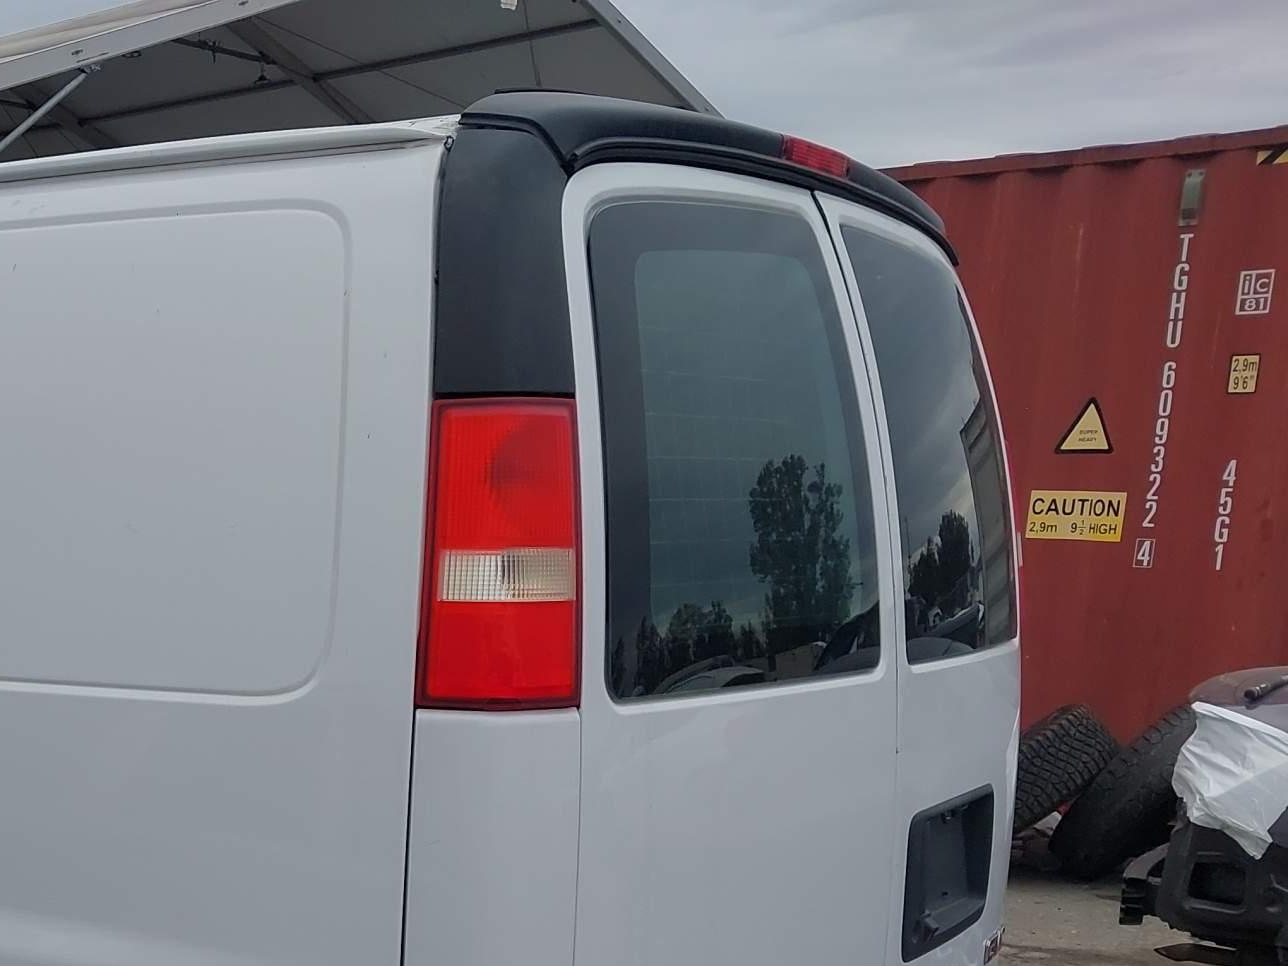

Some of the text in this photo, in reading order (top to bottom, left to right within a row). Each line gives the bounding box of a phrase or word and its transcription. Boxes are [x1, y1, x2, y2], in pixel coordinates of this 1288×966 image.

[1166, 233, 1194, 348] TGHU
[1142, 361, 1176, 528] 609322
[1032, 498, 1121, 517] CAUTION
[1089, 523, 1118, 535] HIGH
[1214, 460, 1237, 570] 45G1
